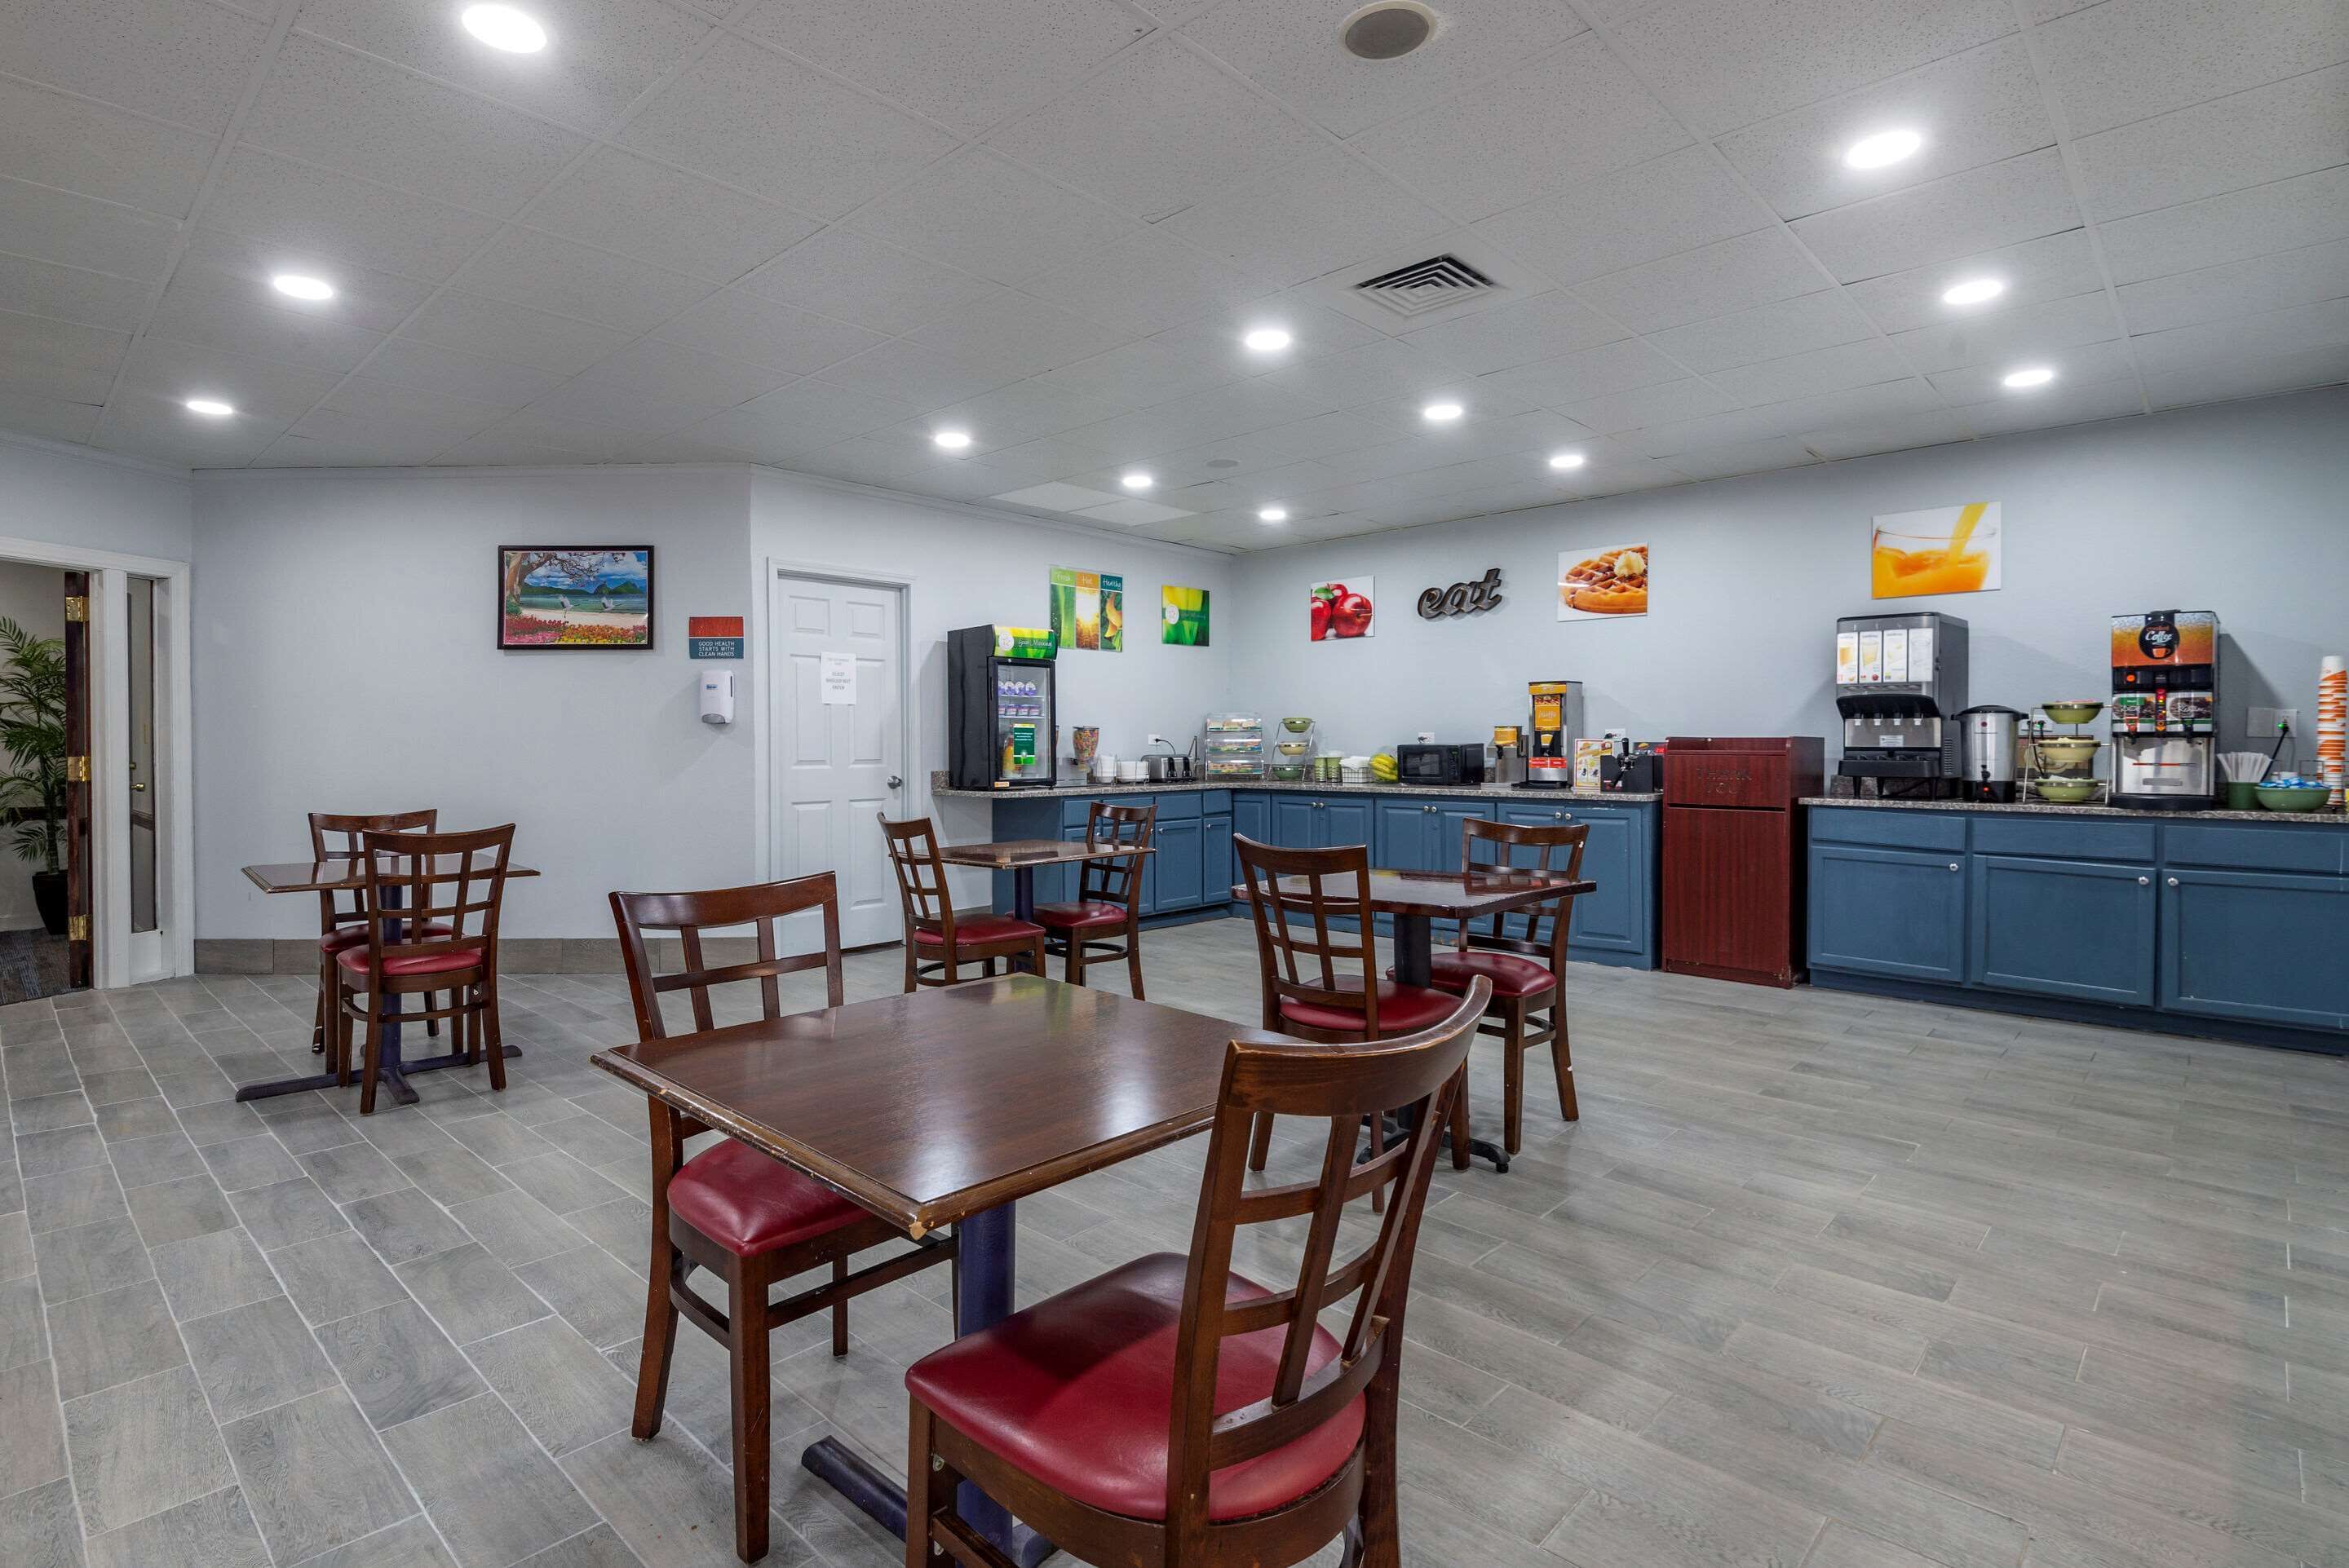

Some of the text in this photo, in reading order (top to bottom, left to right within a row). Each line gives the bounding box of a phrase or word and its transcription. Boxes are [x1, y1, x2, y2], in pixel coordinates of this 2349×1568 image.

[1102, 577, 1121, 590] Healthy
[1418, 568, 1502, 619] eat
[2145, 630, 2173, 643] Coffee
[1696, 767, 1753, 780] THANK
